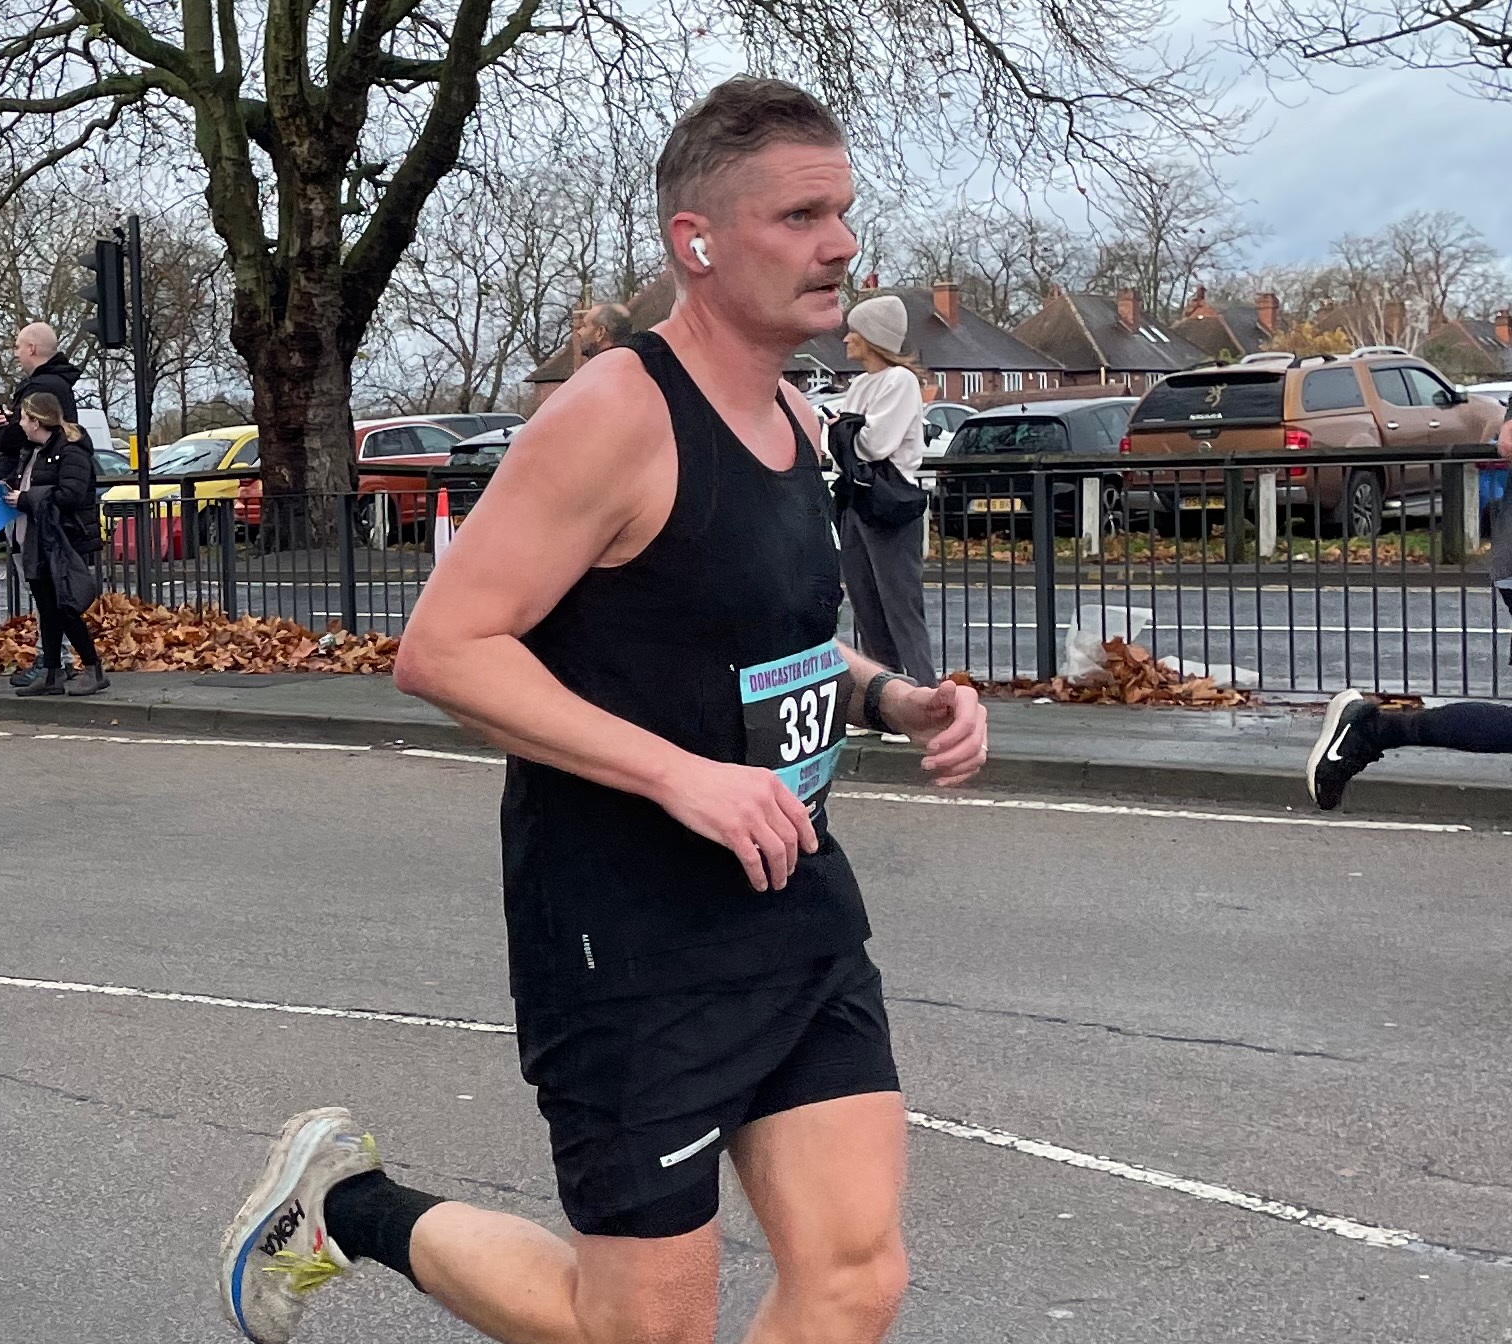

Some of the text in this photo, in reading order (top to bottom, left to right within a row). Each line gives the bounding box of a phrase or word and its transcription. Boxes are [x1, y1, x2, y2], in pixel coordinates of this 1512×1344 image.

[749, 662, 802, 693] DONCASTER
[802, 656, 819, 677] CITY
[779, 680, 838, 762] 337
[258, 1198, 306, 1257] HOKA
